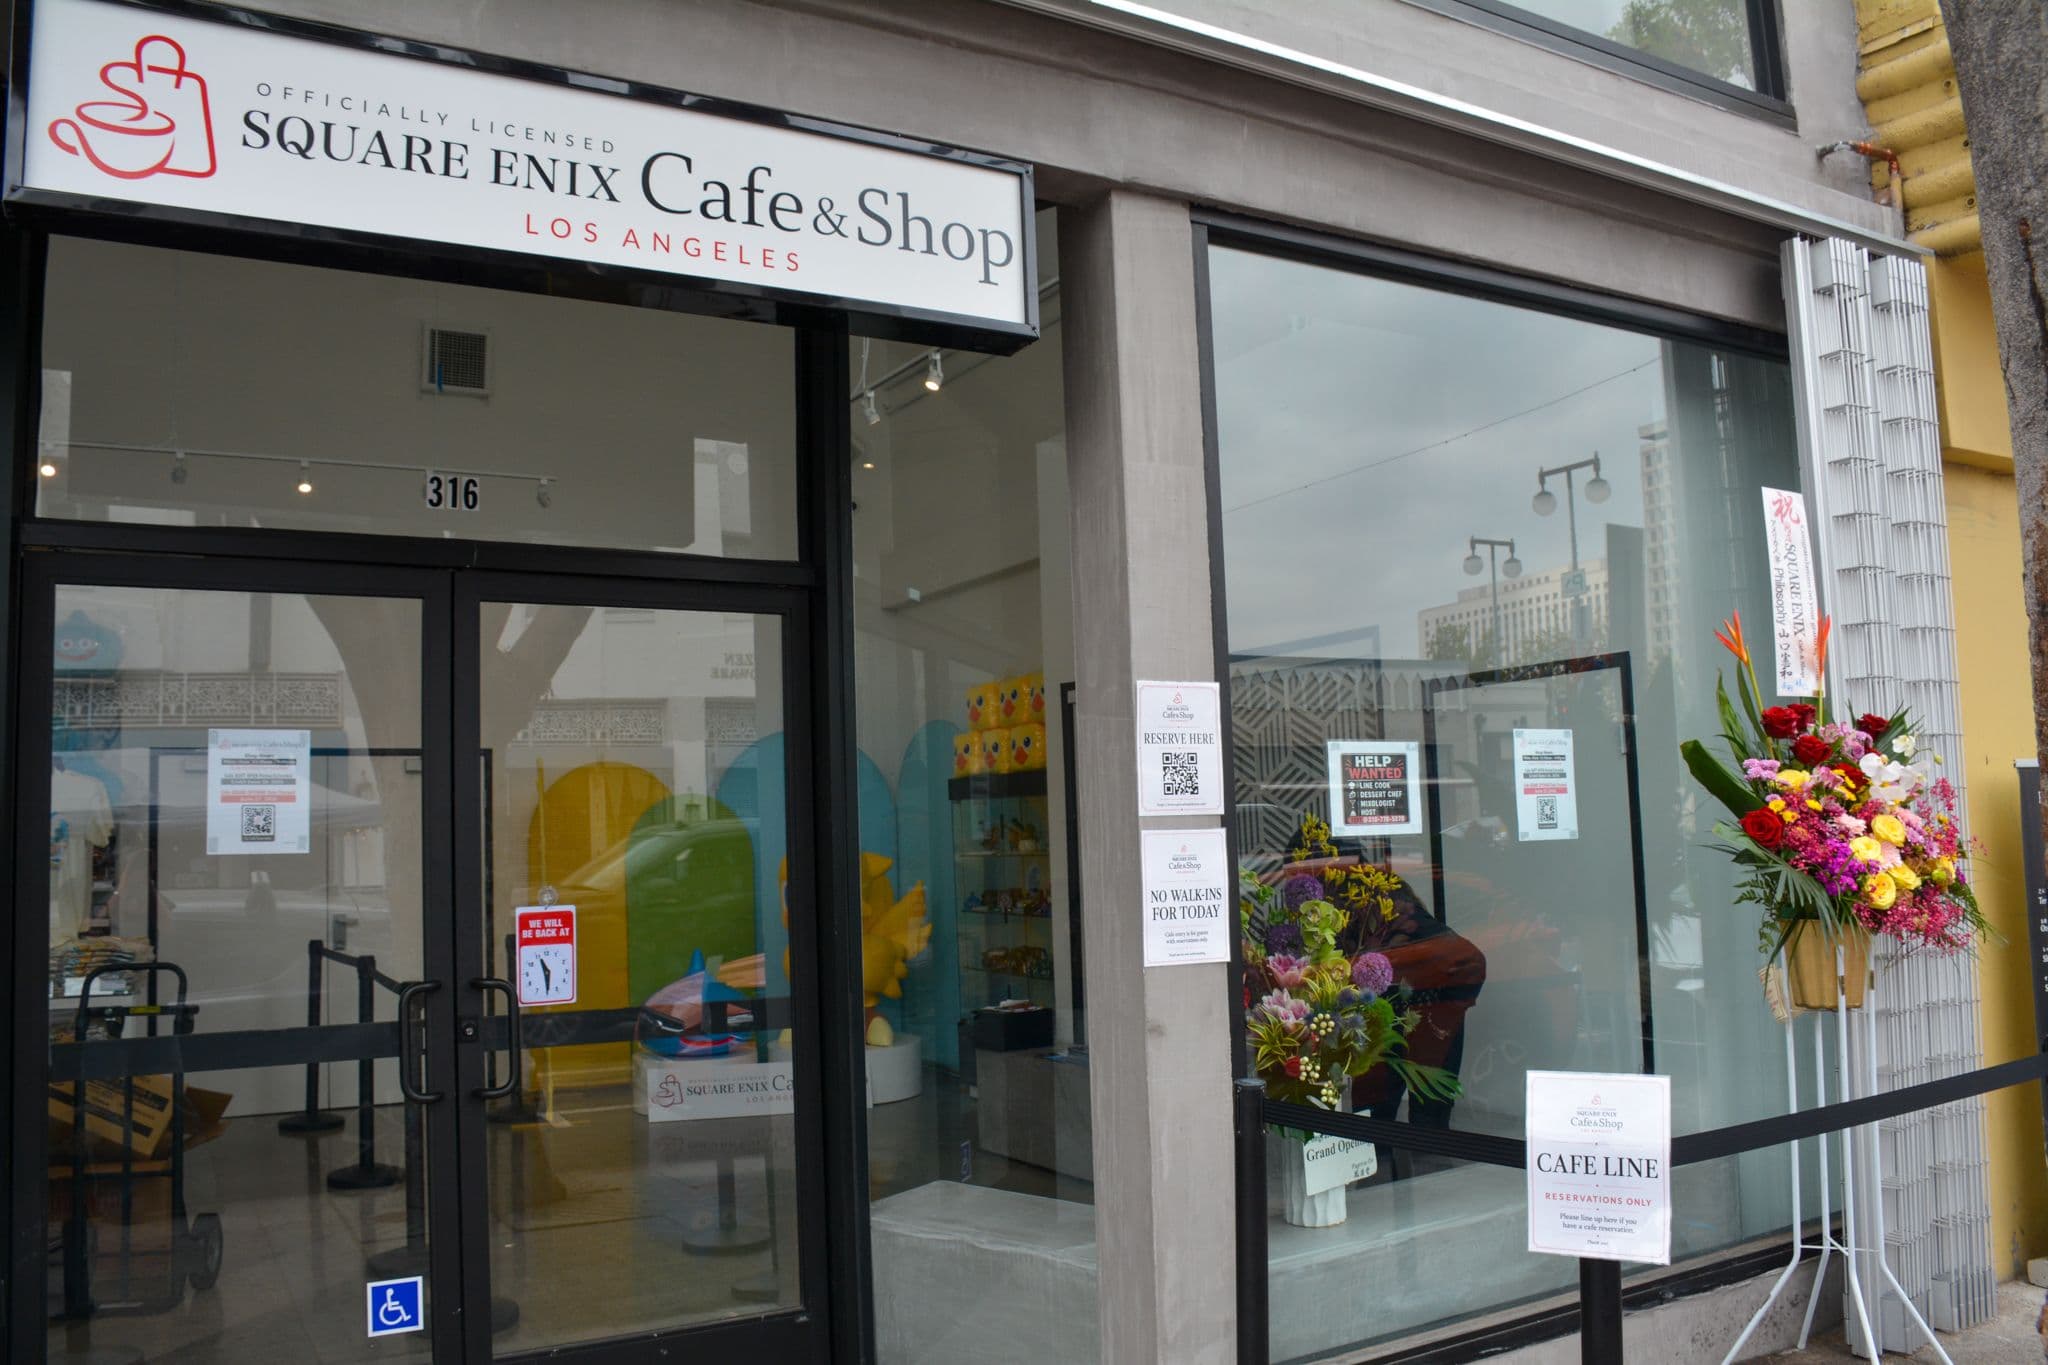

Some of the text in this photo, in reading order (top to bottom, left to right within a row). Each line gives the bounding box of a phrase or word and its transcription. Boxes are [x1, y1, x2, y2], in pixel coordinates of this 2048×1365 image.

[256, 82, 615, 154] OFFICIALLY LICENSED
[241, 109, 469, 180] SQUARE
[489, 148, 622, 203] ENIX
[640, 151, 803, 233] Cafe
[857, 187, 1015, 285] Shop
[525, 213, 800, 272] LOS ANGELES
[428, 476, 478, 510] 316
[1772, 491, 1801, 524] 祝
[1784, 544, 1801, 599] SQUARE
[1774, 567, 1788, 626] Philosophy
[1791, 602, 1806, 637] ENIX
[1144, 732, 1215, 745] RESERVE HERE
[1354, 755, 1392, 768] HELP
[1348, 768, 1402, 778] WANTED
[1150, 888, 1222, 903] NO WALK-INS
[1152, 904, 1220, 920] FOR TODAY
[528, 918, 562, 928] WE WILL
[522, 928, 570, 938] BE BACK AT
[686, 1083, 735, 1096] SQUARE
[738, 1081, 768, 1093] ENIX
[772, 1074, 794, 1092] Ca
[1306, 1144, 1336, 1162] Grand
[1536, 1152, 1659, 1179] CAFE LINE
[1545, 1192, 1652, 1207] RESERVATIONS ONLY
[1560, 1212, 1638, 1227] Please line up here if you
[1598, 1224, 1635, 1234] reservation.
